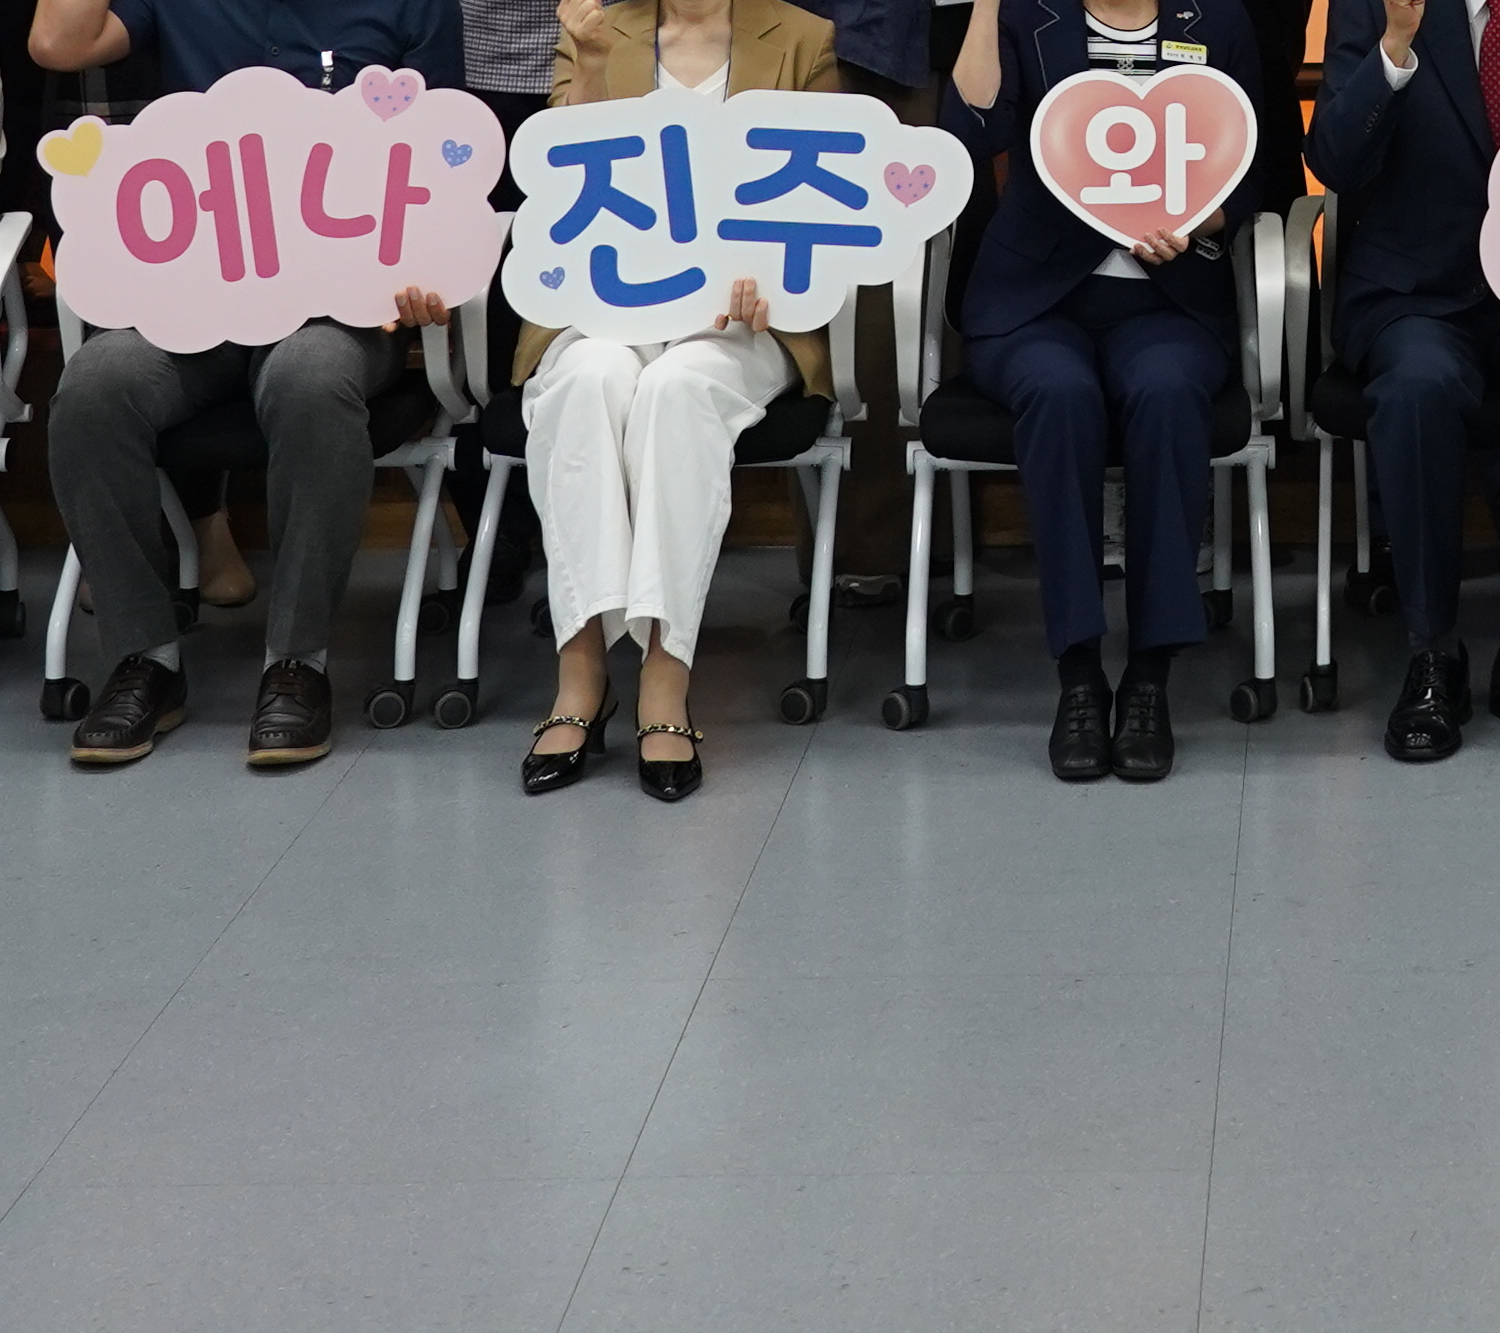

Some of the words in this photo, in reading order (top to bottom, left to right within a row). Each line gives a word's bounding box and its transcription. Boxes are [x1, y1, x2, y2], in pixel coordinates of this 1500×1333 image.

[116, 135, 430, 283] 에나
[547, 124, 883, 308] 진주
[1079, 104, 1207, 217] 와
